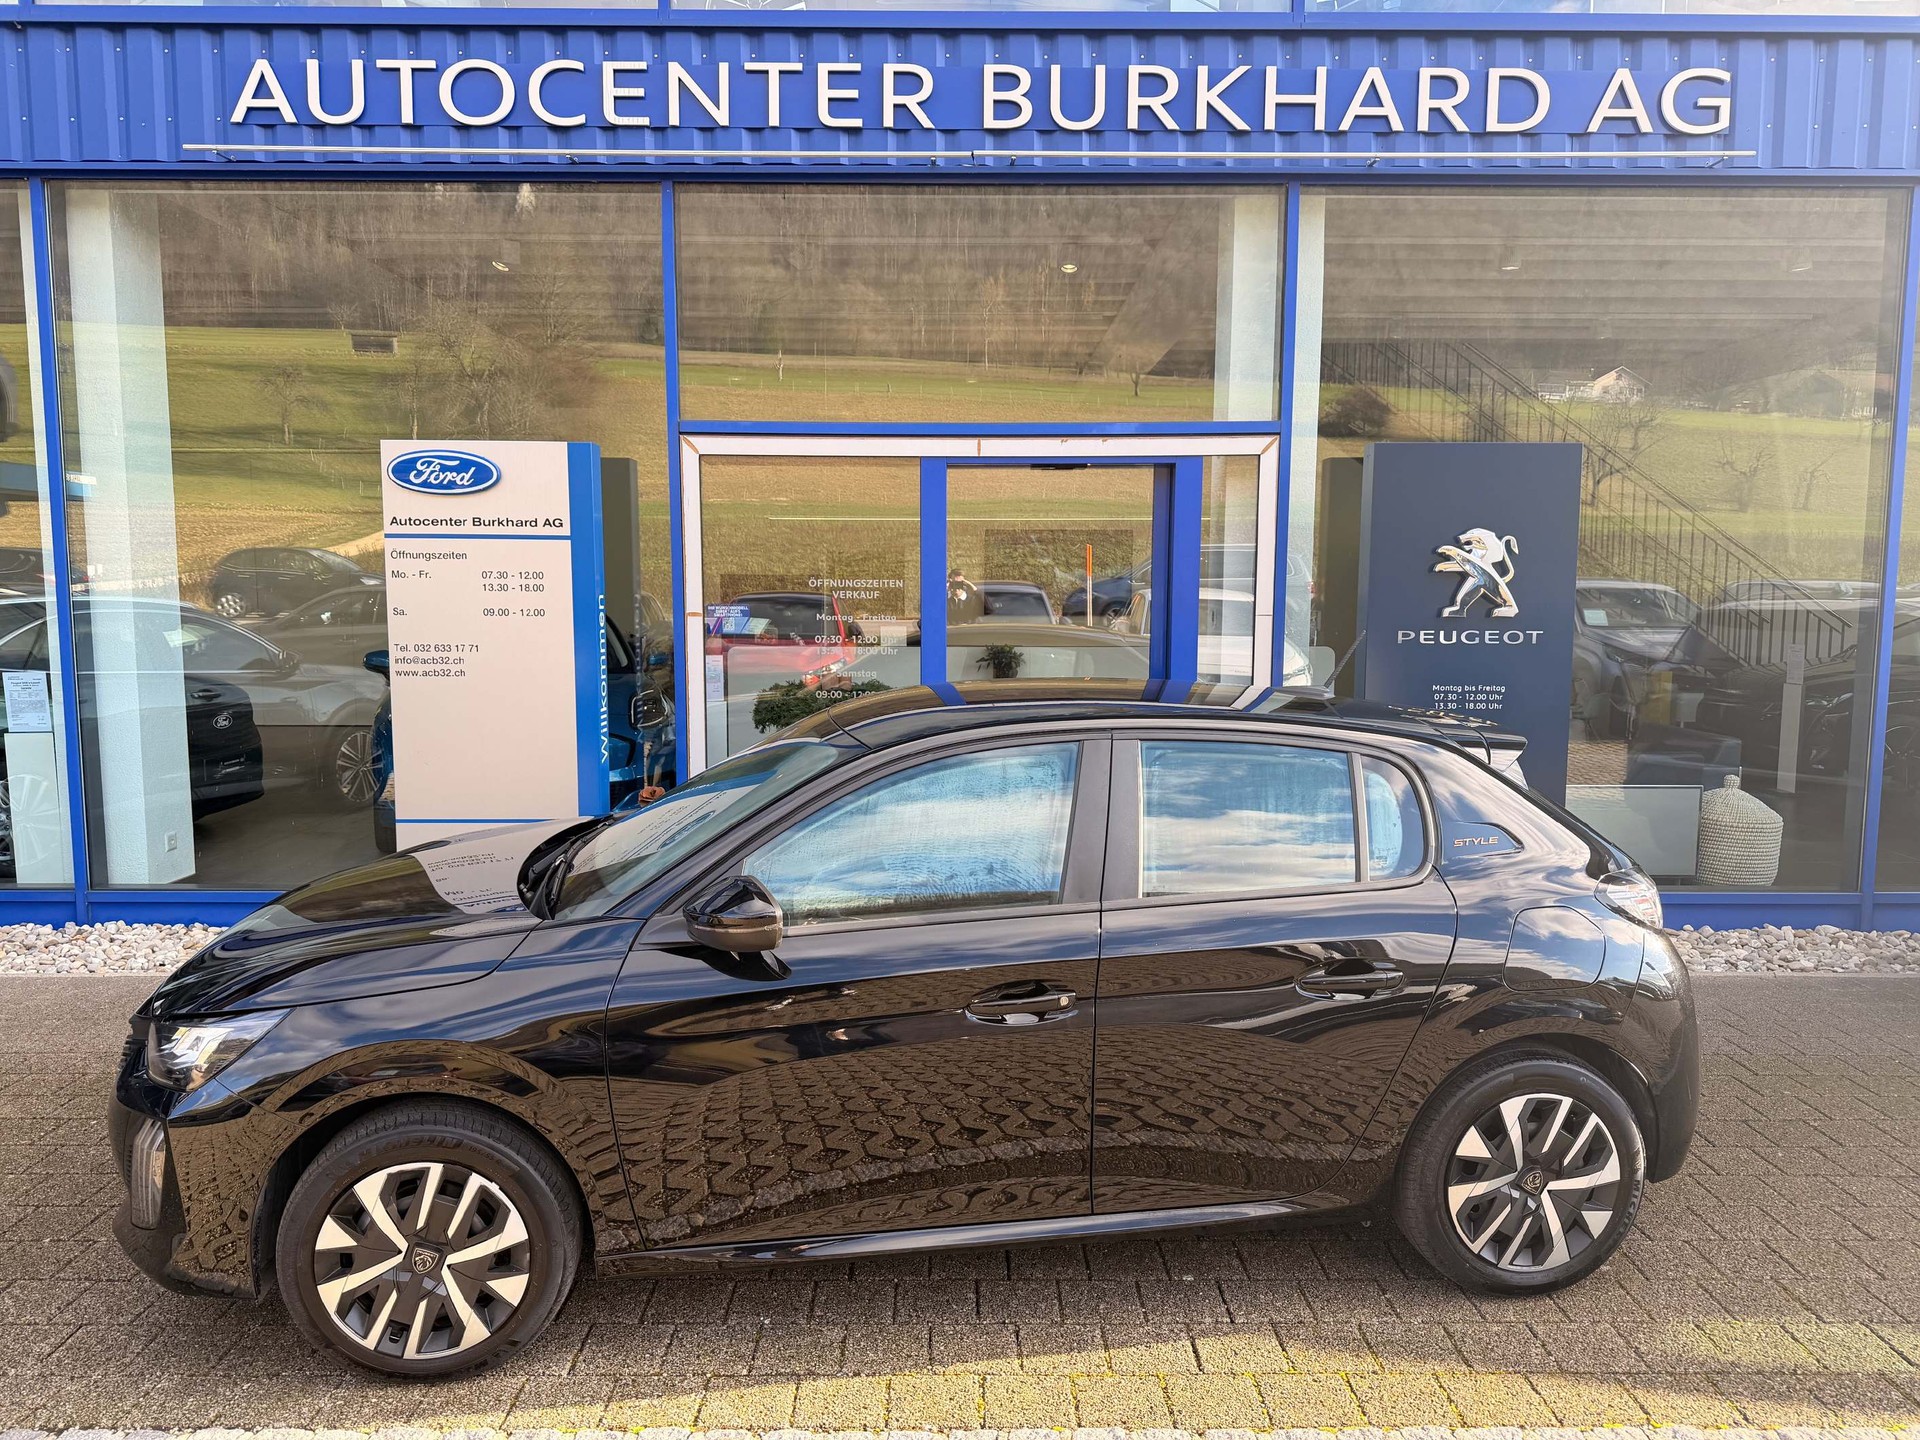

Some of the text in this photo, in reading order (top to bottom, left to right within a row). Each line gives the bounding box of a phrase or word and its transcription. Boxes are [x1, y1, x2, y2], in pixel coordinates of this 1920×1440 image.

[229, 58, 1732, 134] AUTOCENTER BURKHARD AG
[409, 457, 476, 486] Ford
[389, 516, 564, 528] Autocenter Burkhard AG
[390, 547, 468, 562] Öffnungszeiten
[391, 570, 409, 579] Mo.
[418, 570, 432, 579] Fr.
[481, 570, 509, 580] 07.30
[518, 571, 545, 580] 12.00
[808, 576, 904, 588] ÖFFNUNGSZEITEN
[482, 583, 509, 592] 13.30
[518, 583, 545, 592] 18.00
[831, 590, 881, 599] VERKAUF
[392, 606, 408, 616] Sa.
[482, 607, 510, 617] 09.00
[519, 608, 546, 617] 12.00
[816, 613, 854, 623] Montag
[862, 613, 897, 622] Freitag
[814, 635, 843, 644] 07:30
[852, 635, 879, 644] 12:00
[1396, 630, 1544, 645] PEUGEOT
[393, 643, 479, 653] Tel. 032 633 17 71
[880, 646, 899, 655] Uhr
[394, 655, 465, 665] info@acb32.ch
[394, 668, 466, 677] www.acb32.ch
[836, 669, 878, 679] Samstag
[598, 594, 609, 764] Willkommen
[1432, 684, 1506, 693] Montag bis Freitag
[815, 690, 843, 699] 09:00
[1433, 693, 1458, 701] 07.30
[1465, 693, 1488, 701] 12.00
[1488, 693, 1503, 701] Uhr
[1434, 702, 1457, 710] 13.30
[1465, 702, 1487, 710] 18.00
[1488, 702, 1503, 710] Uhr
[1453, 836, 1499, 848] STYLE
